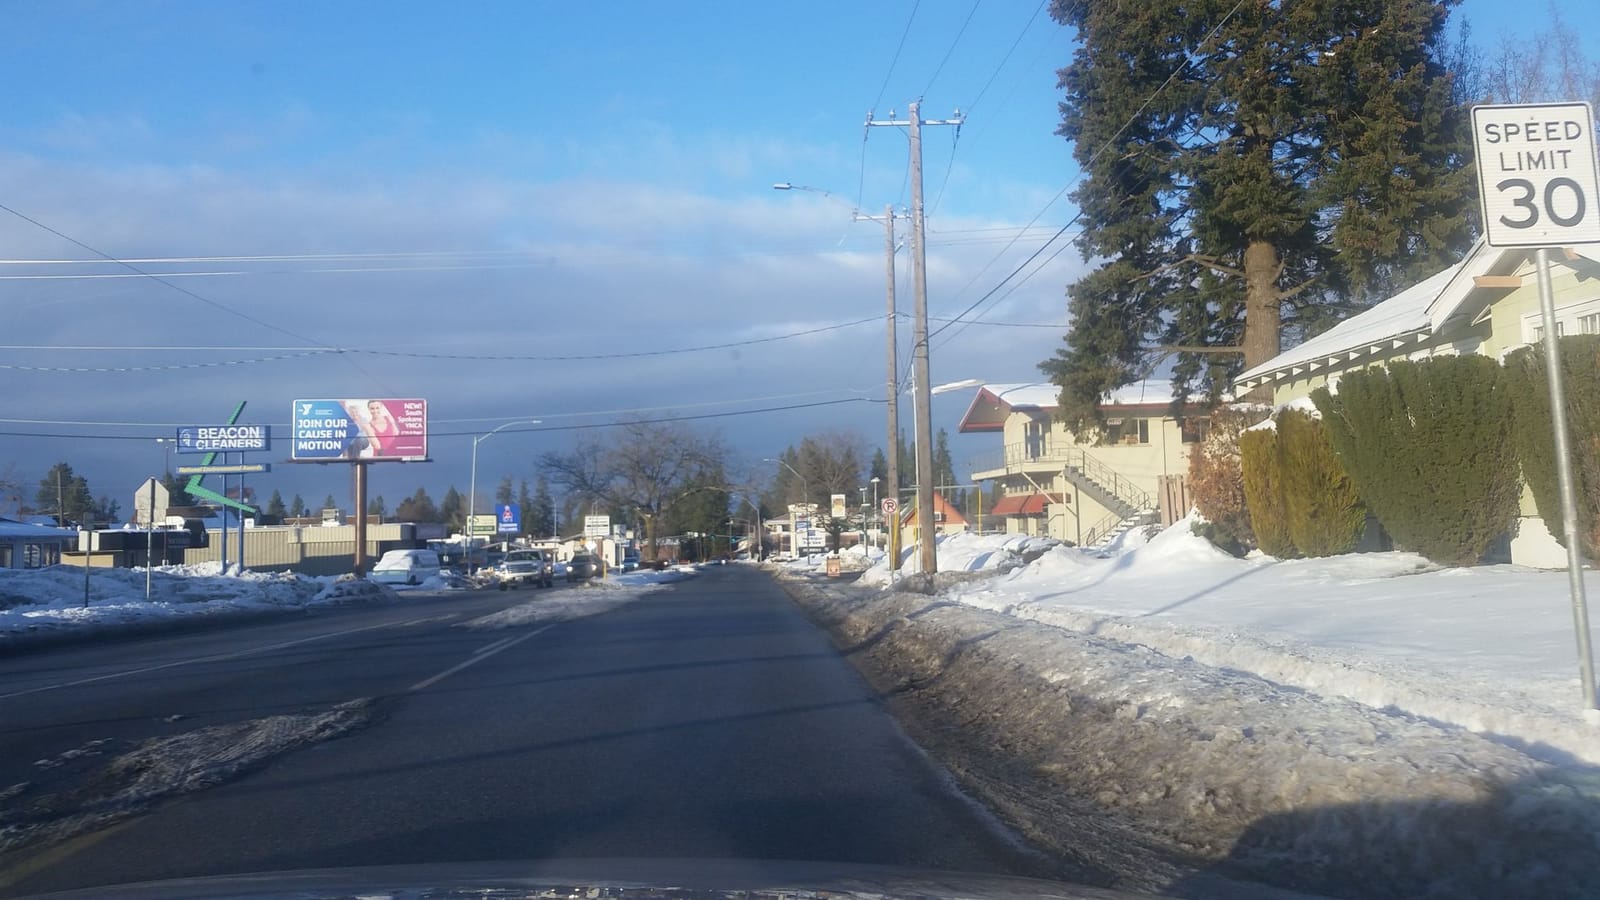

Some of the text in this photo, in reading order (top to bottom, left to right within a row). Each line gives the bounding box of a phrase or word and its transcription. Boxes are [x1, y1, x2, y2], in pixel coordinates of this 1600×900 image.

[1485, 121, 1582, 143] SPEED
[1500, 150, 1571, 171] LIMIT
[1496, 177, 1586, 229] 30
[298, 419, 348, 428] JOIN OUR
[198, 426, 260, 439] BEACON
[298, 430, 347, 439] CAUSE IN
[195, 439, 263, 450] CLEANERS
[298, 440, 342, 450] MOTION
